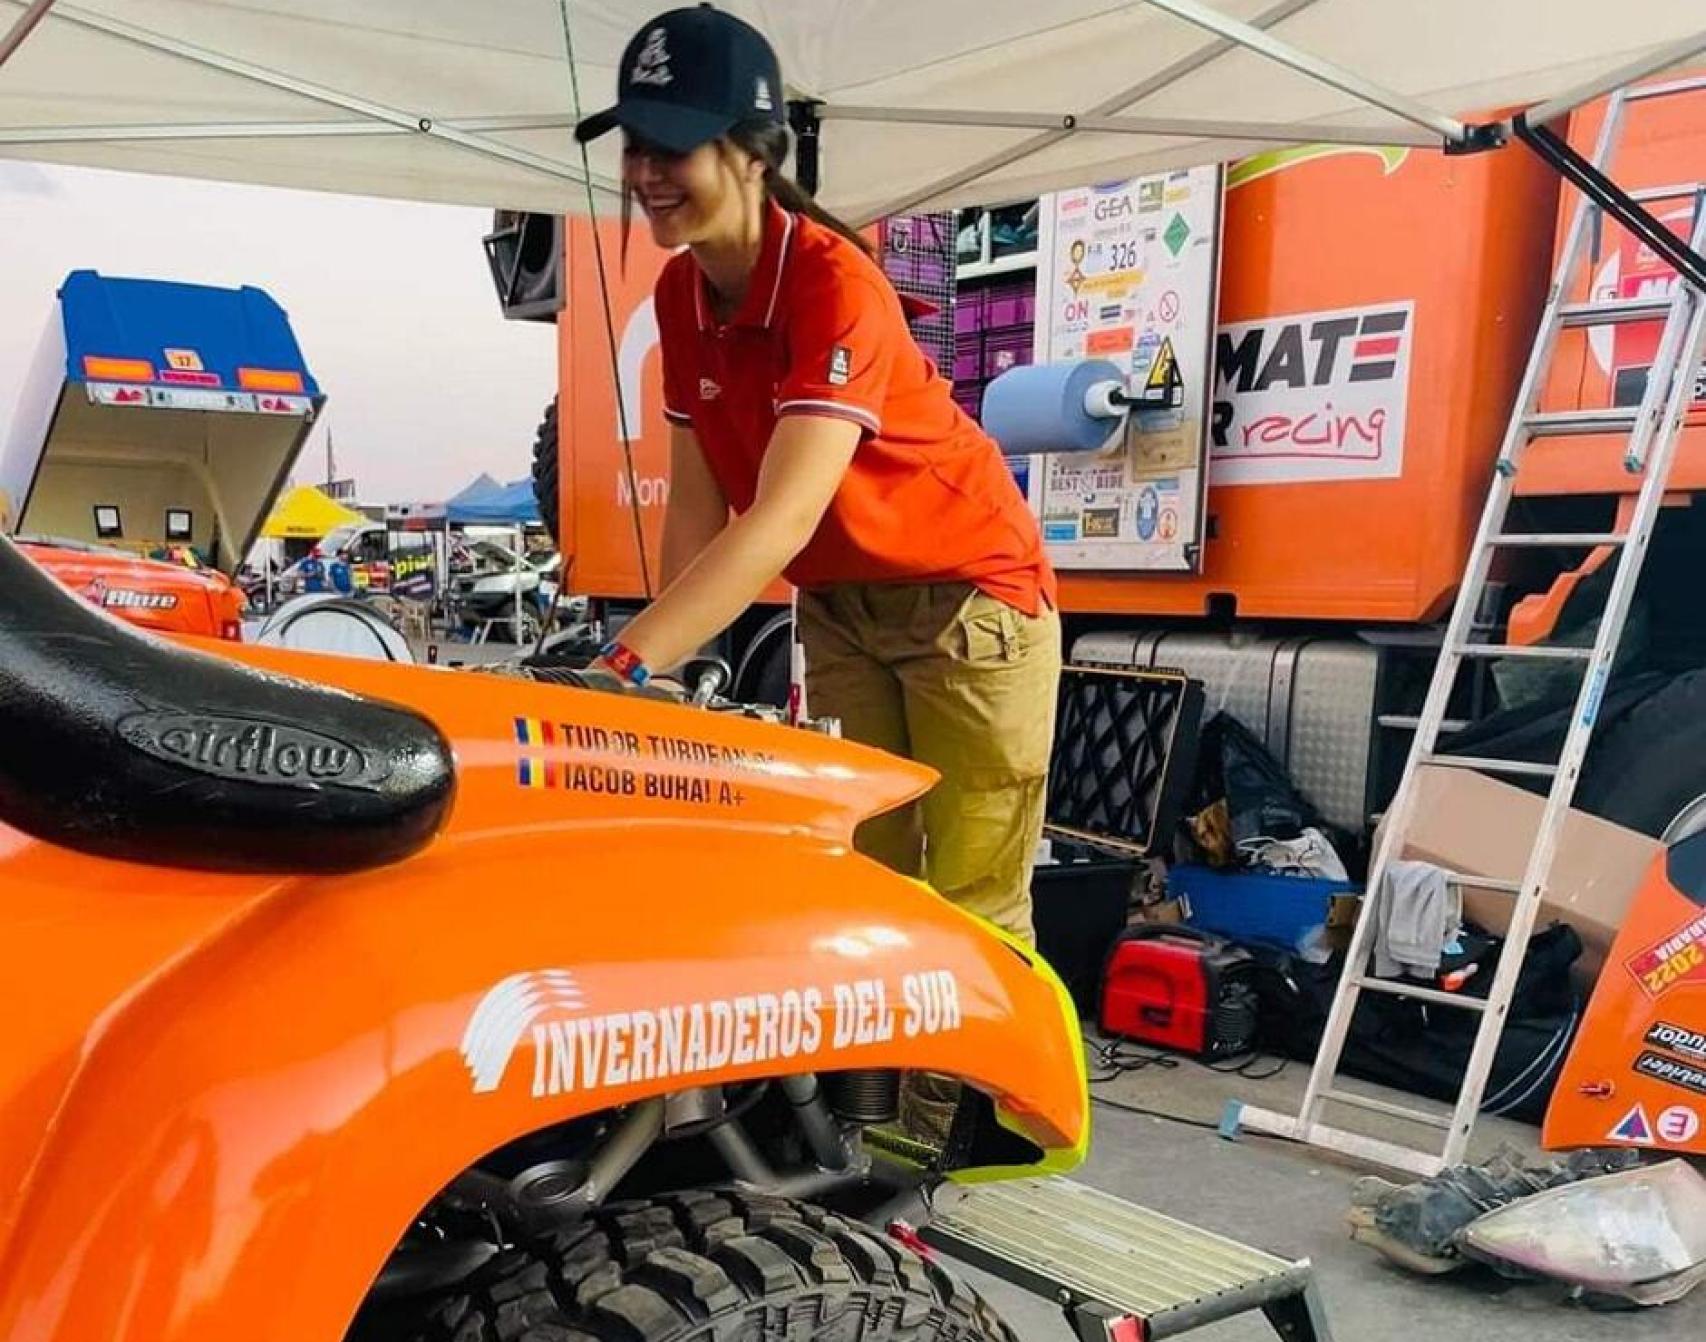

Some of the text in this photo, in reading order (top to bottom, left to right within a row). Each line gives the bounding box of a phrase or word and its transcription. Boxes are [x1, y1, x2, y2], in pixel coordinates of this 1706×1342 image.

[1109, 241, 1137, 272] 326
[1241, 404, 1386, 459] racing
[160, 723, 352, 778] airflow
[564, 762, 637, 795] IACOB
[719, 780, 747, 806] A+
[1643, 943, 1703, 992] 2022
[532, 969, 961, 1098] INVERNADEROS DEL SUR
